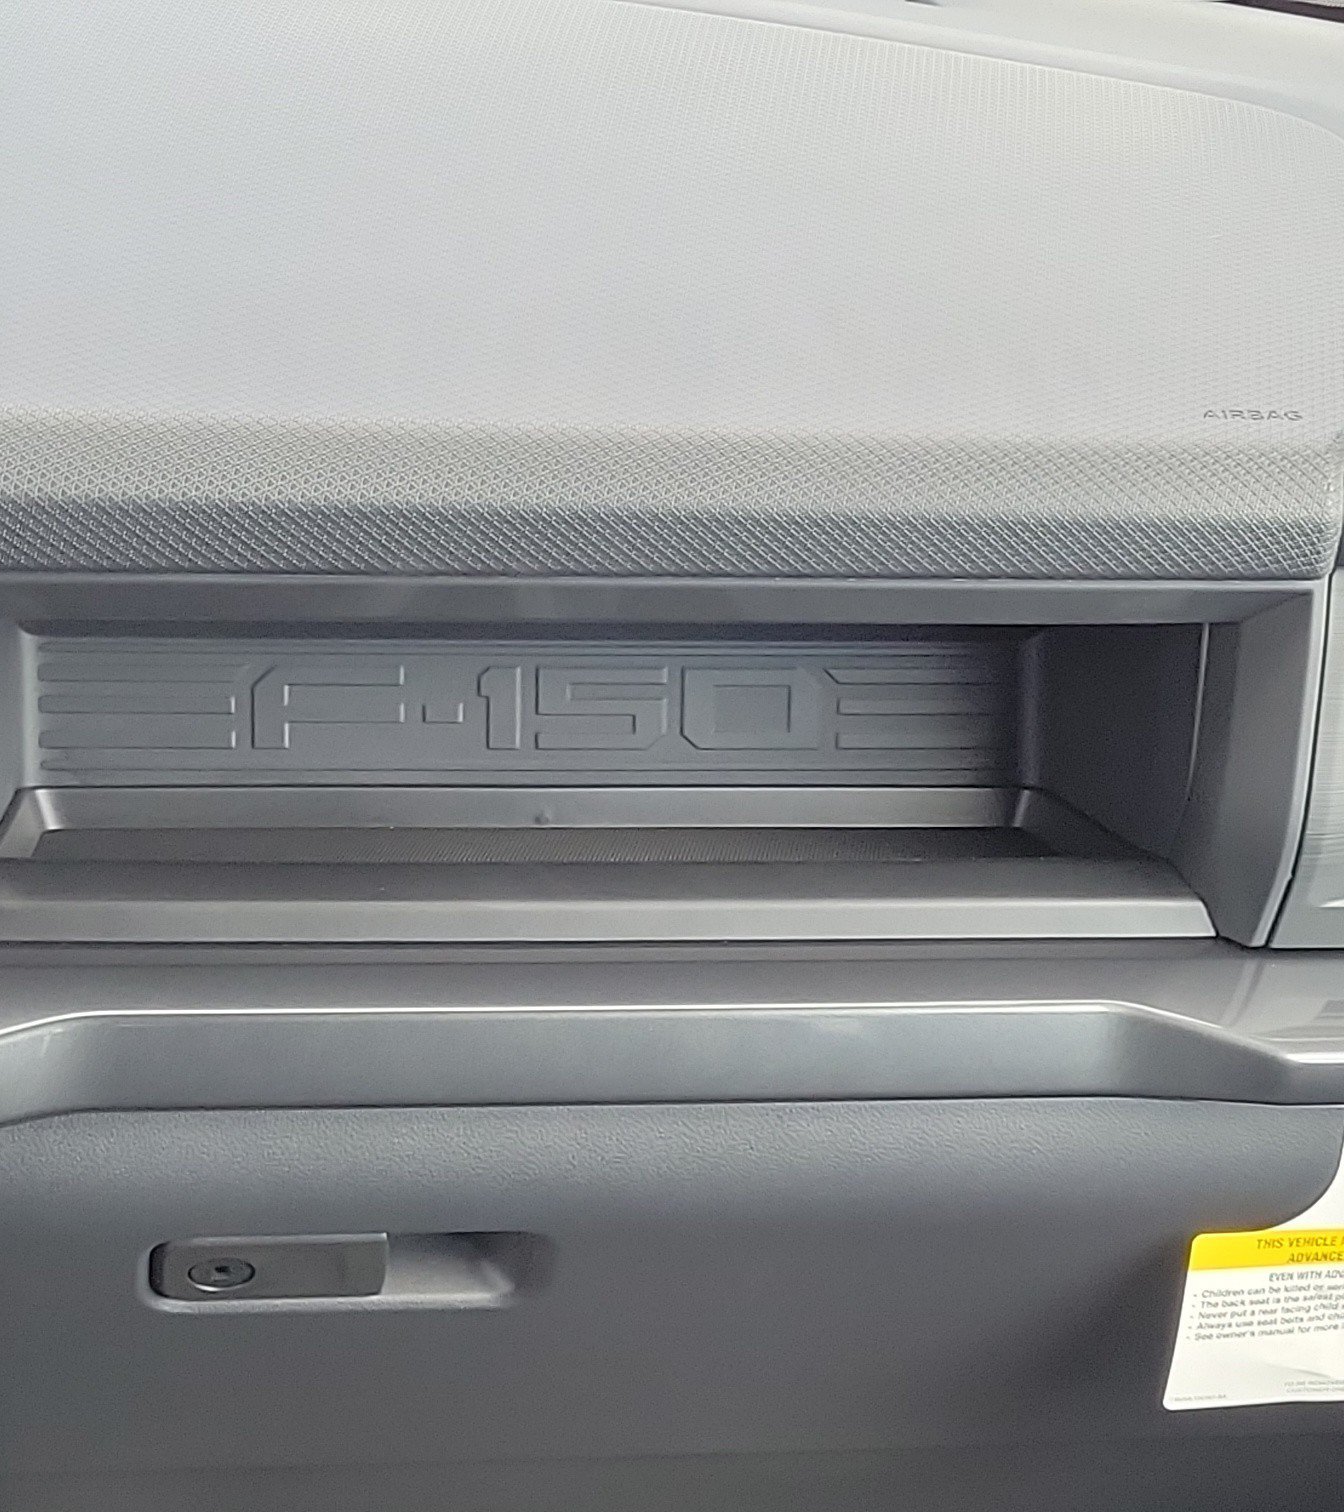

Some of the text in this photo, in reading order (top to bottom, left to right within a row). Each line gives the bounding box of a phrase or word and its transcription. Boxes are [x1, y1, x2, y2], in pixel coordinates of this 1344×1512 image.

[1203, 409, 1303, 421] AIRBAG
[1256, 1238, 1284, 1250] THIS
[1288, 1236, 1337, 1248] VEHICLE
[1269, 1273, 1294, 1282] EVEN
[1297, 1270, 1323, 1281] WITH
